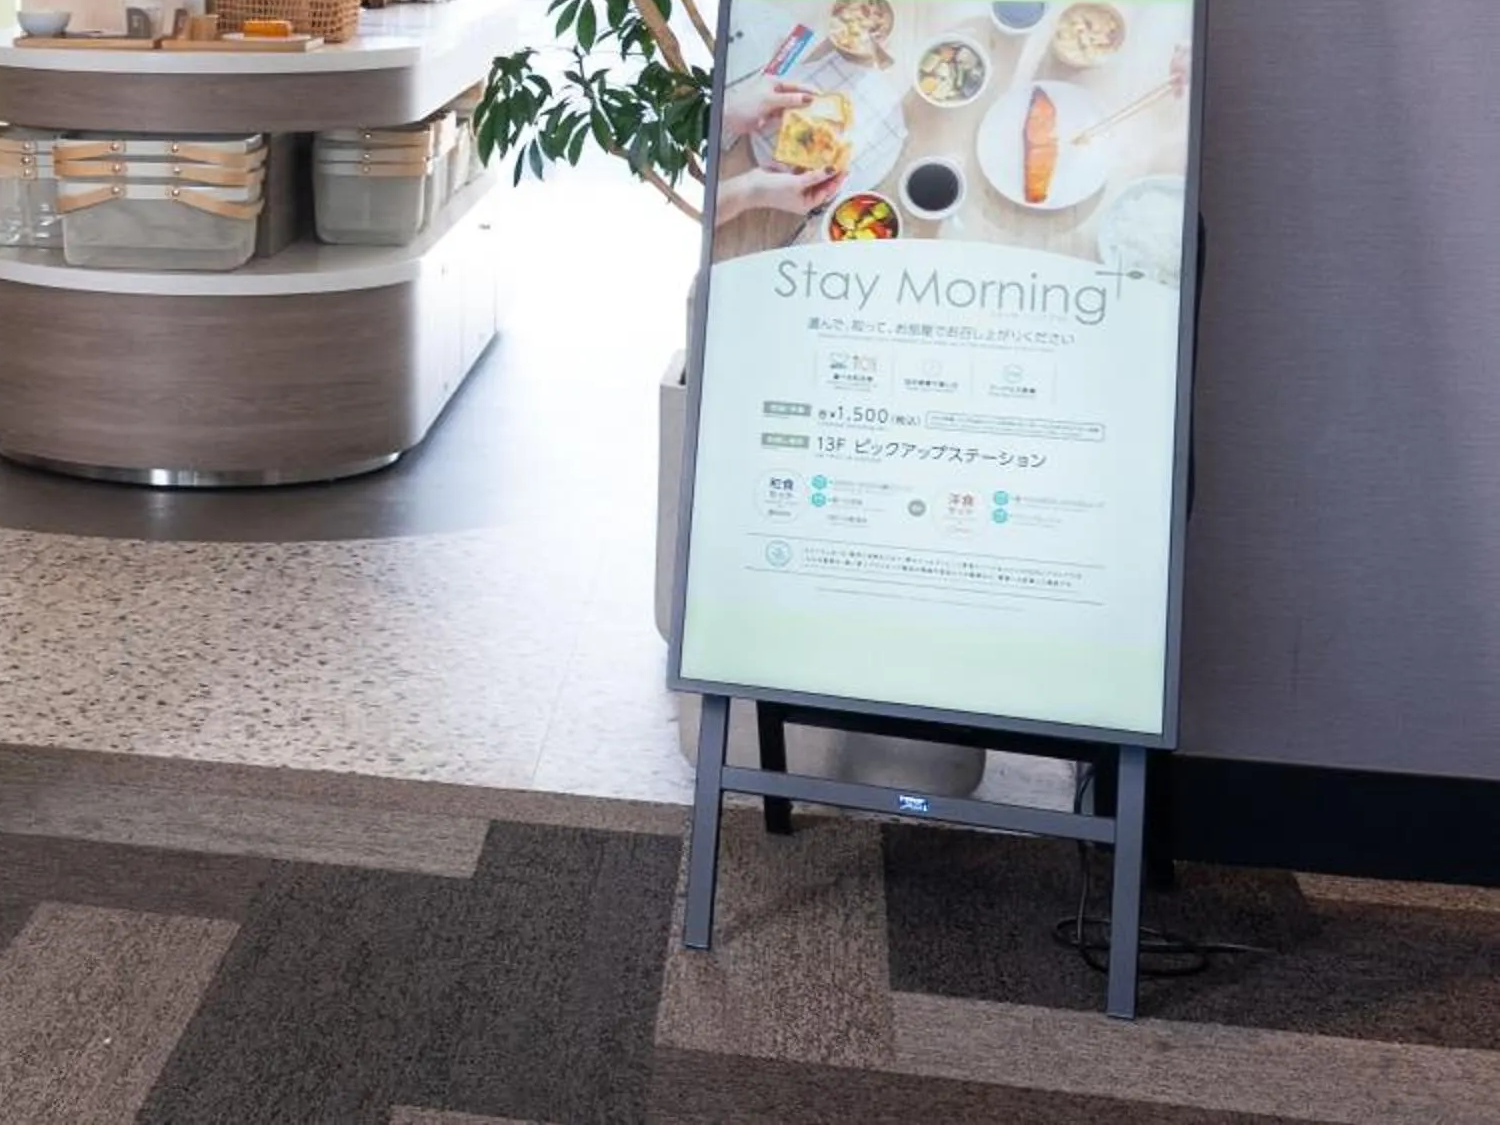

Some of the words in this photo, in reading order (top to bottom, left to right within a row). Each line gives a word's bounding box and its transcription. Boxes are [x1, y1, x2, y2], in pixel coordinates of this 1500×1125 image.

[774, 259, 880, 310] Stay
[896, 268, 1107, 325] Morning
[817, 436, 846, 452] 13F
[855, 438, 1048, 468] ピックアップステーション
